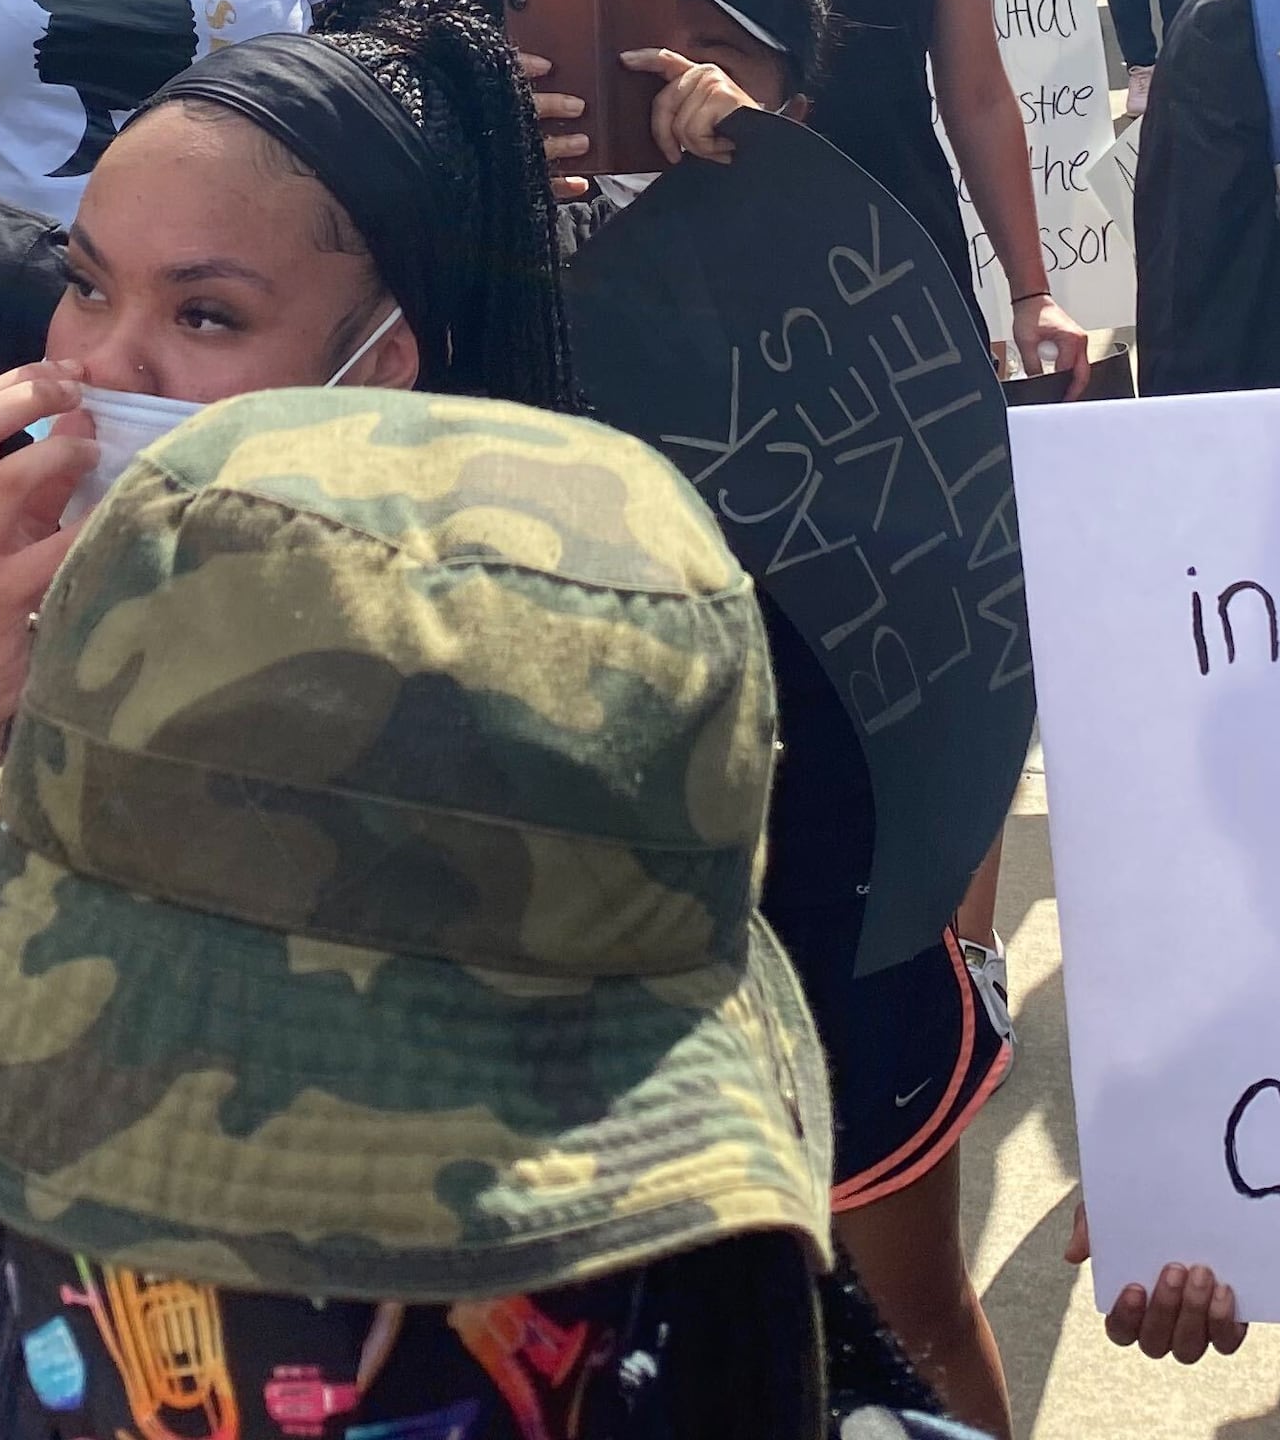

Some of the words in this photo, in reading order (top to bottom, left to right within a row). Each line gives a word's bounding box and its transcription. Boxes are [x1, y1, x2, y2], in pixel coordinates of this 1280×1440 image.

[660, 345, 922, 735] BLACK
[758, 306, 973, 683] LIVES
[827, 203, 1032, 692] MATTER
